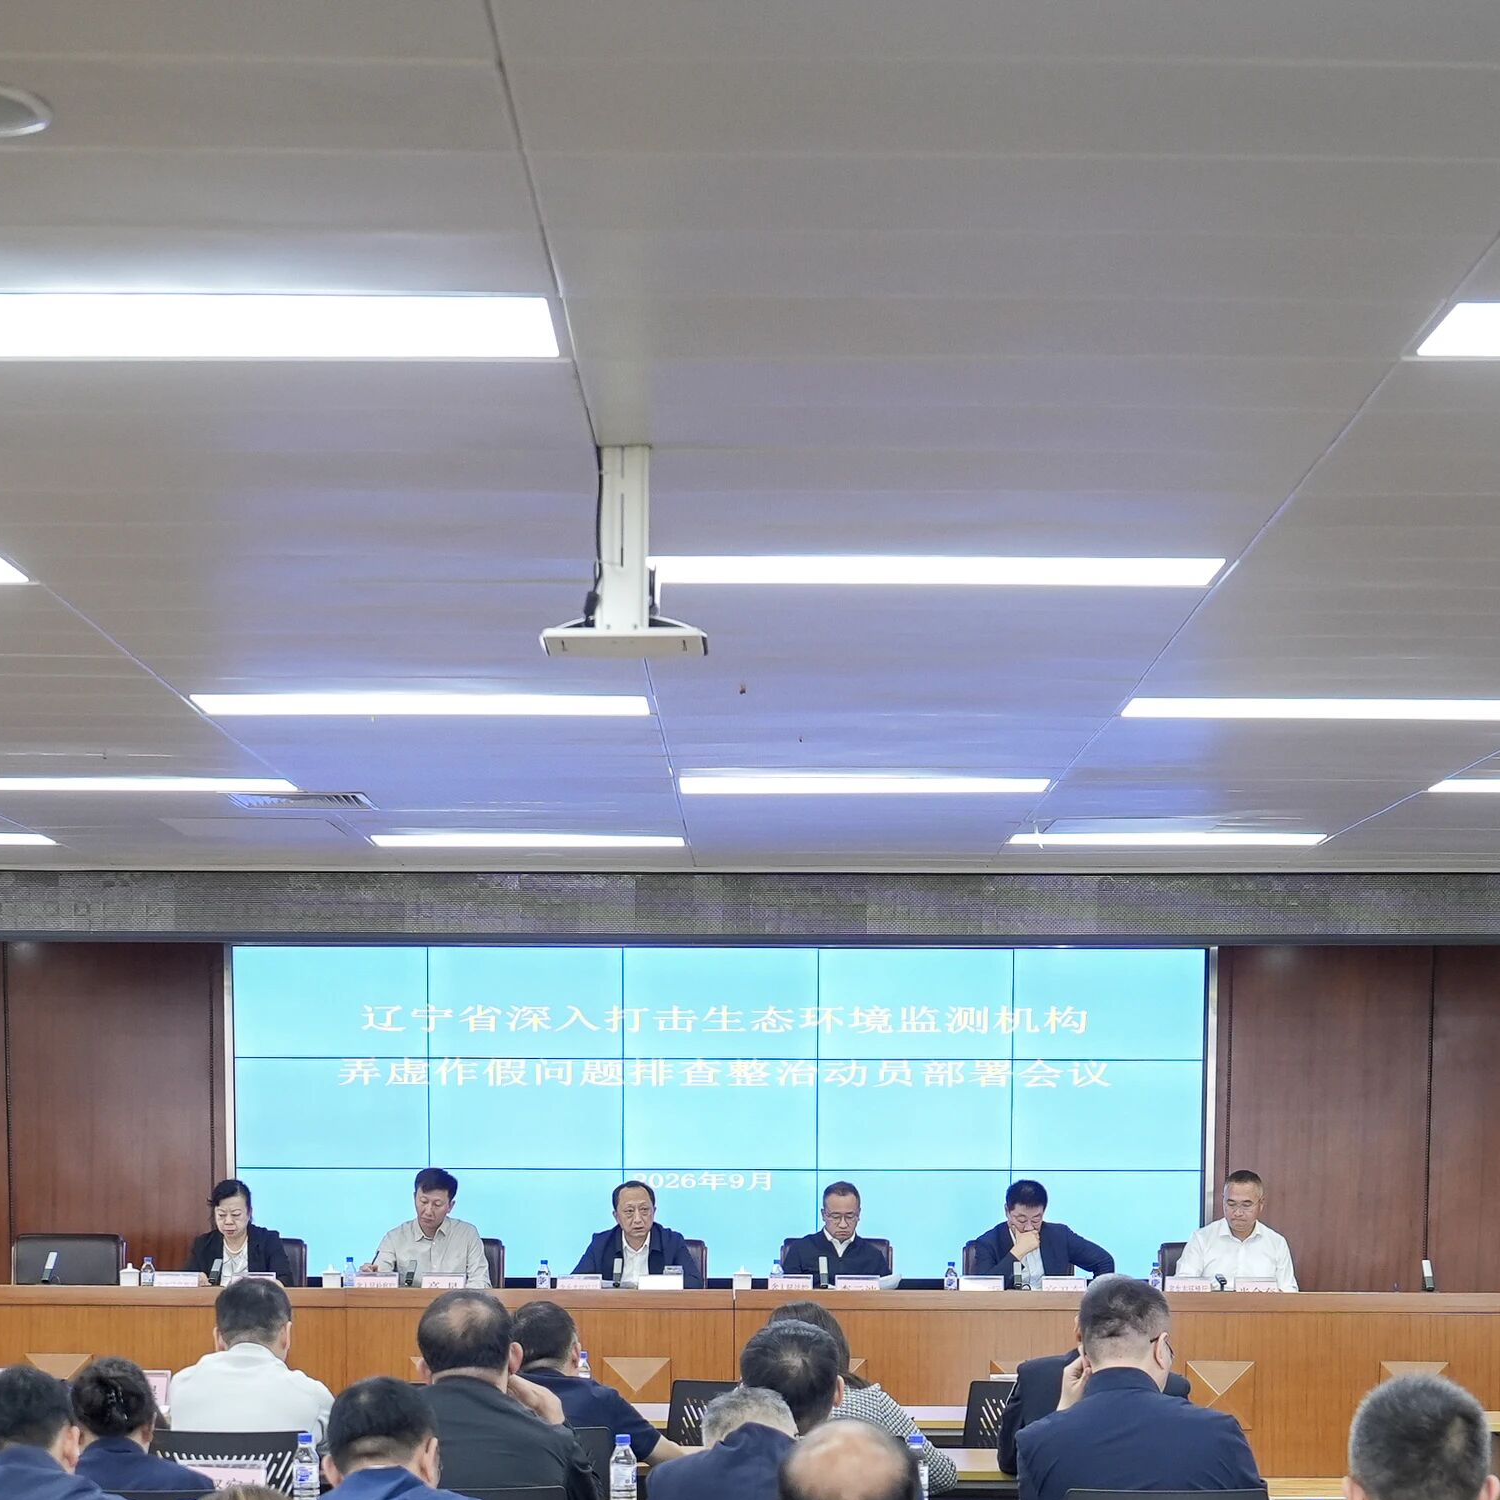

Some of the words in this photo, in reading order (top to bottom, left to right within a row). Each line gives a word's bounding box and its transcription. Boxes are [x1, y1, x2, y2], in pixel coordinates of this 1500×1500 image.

[361, 1004, 1088, 1034] 辽宁省深入打击生态环境监测机构
[339, 1057, 1112, 1088] 弄虚作假问题排查整治动员部署会议
